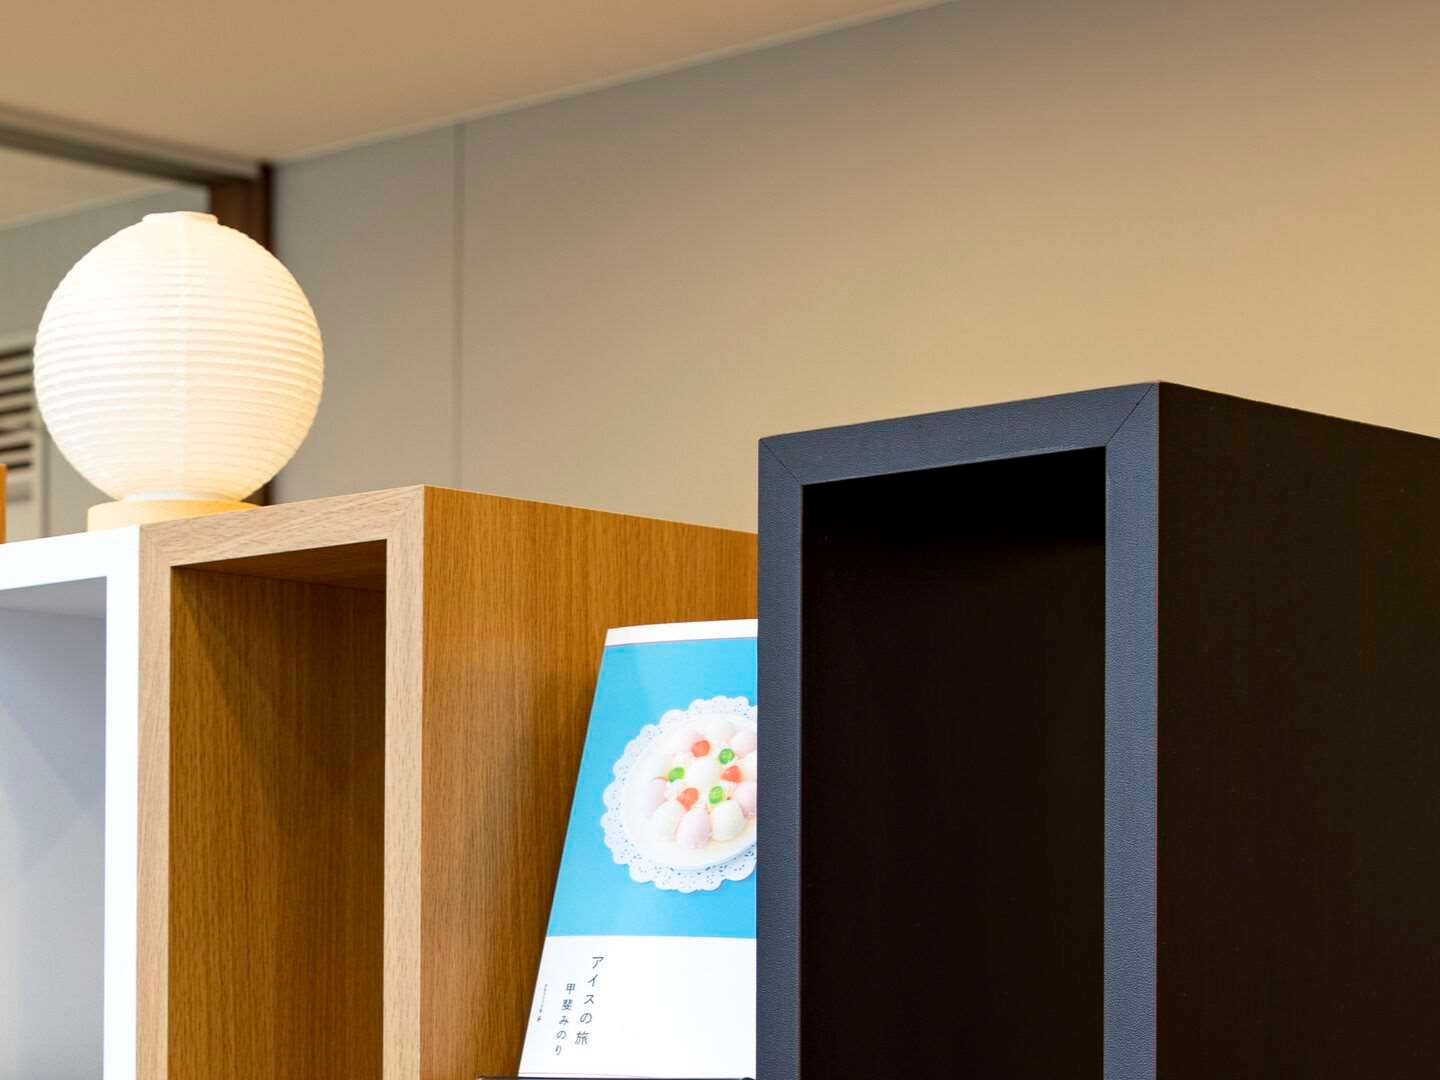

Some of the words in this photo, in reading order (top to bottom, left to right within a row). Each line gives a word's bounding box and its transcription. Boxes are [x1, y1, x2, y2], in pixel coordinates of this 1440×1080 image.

[554, 982, 576, 1056] 甲斐みのり
[574, 955, 605, 1046] アイスの旅
